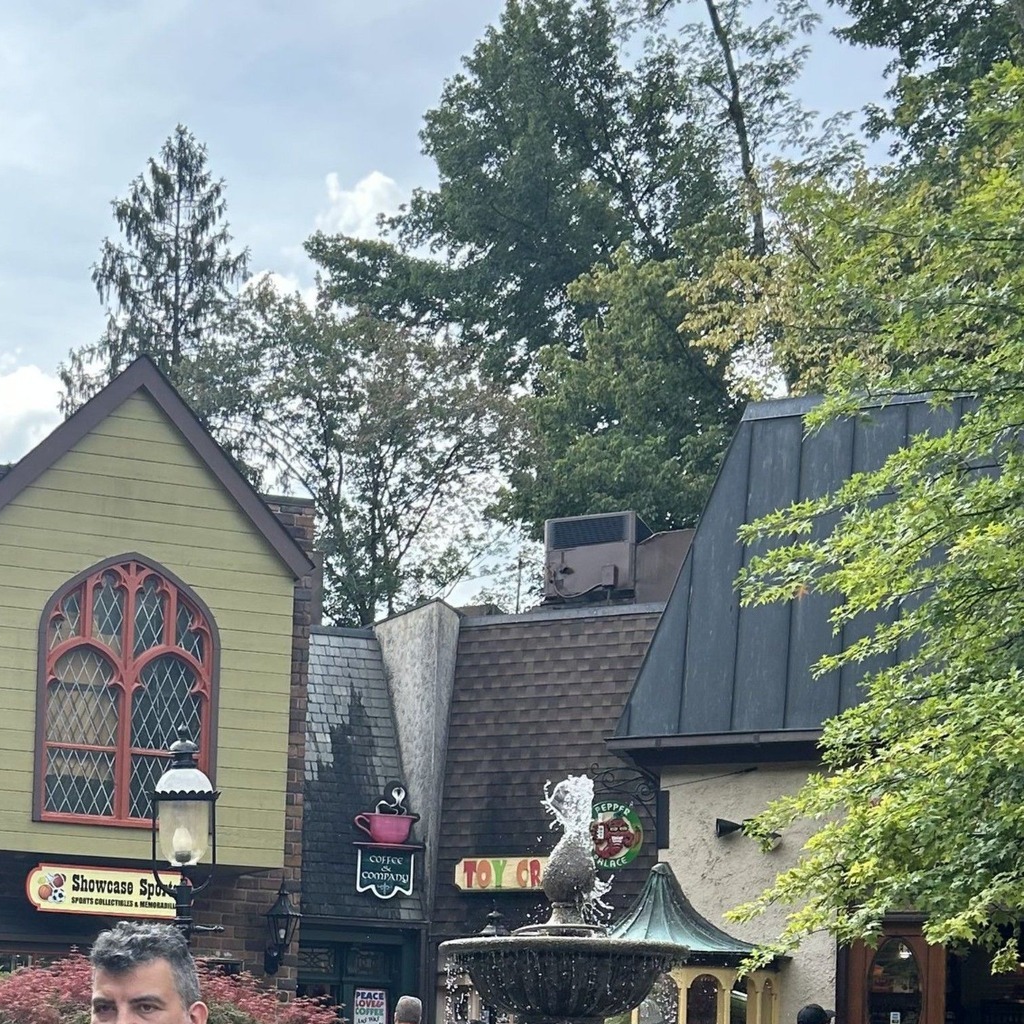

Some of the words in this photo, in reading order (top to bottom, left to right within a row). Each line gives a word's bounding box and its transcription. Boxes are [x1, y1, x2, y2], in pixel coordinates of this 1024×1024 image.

[369, 854, 404, 865] COFFEE
[463, 859, 507, 888] TOY
[72, 873, 134, 895] Showcase
[71, 896, 94, 905] SPORTS
[94, 897, 134, 908] COLLECTIBLES
[356, 991, 384, 1000] PEACE
[355, 1007, 384, 1016] COFFEE
